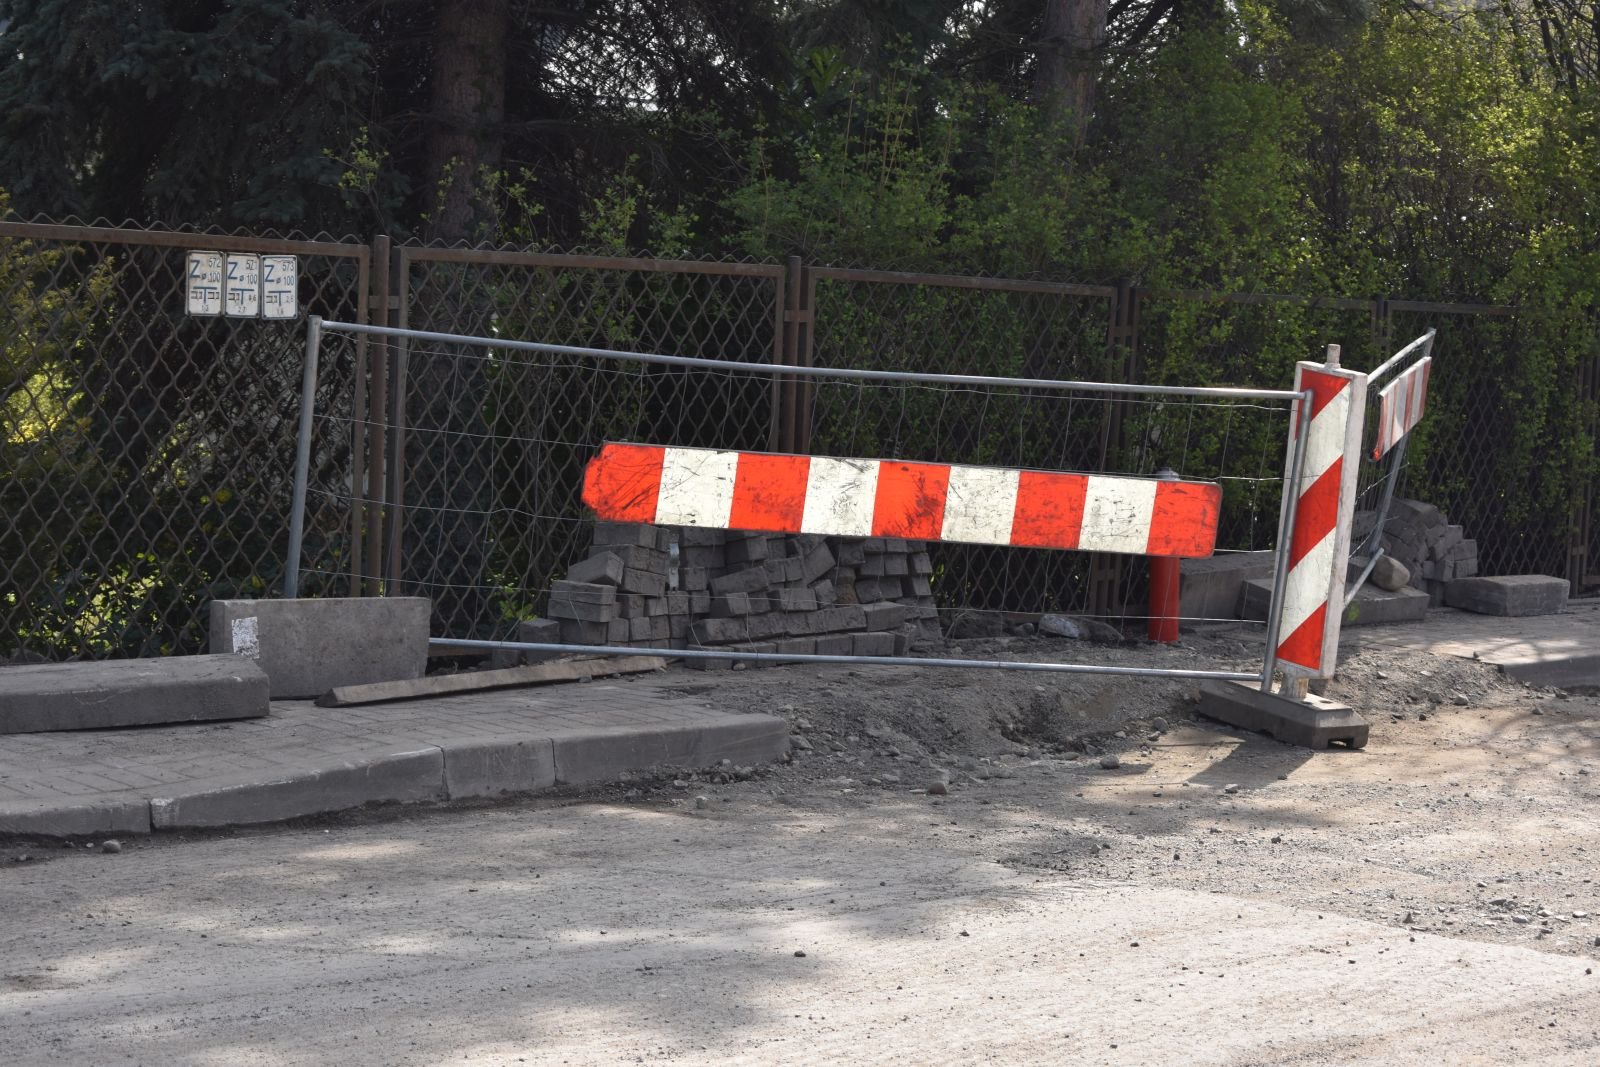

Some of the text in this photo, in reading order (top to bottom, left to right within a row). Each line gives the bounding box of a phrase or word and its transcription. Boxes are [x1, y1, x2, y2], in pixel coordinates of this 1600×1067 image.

[208, 257, 221, 268] 572
[282, 261, 295, 271] 573
[190, 260, 201, 278] Z
[227, 262, 238, 279] Z
[264, 265, 275, 282] Z
[208, 272, 221, 282] 100
[246, 274, 258, 285] 100
[283, 275, 294, 286] 100
